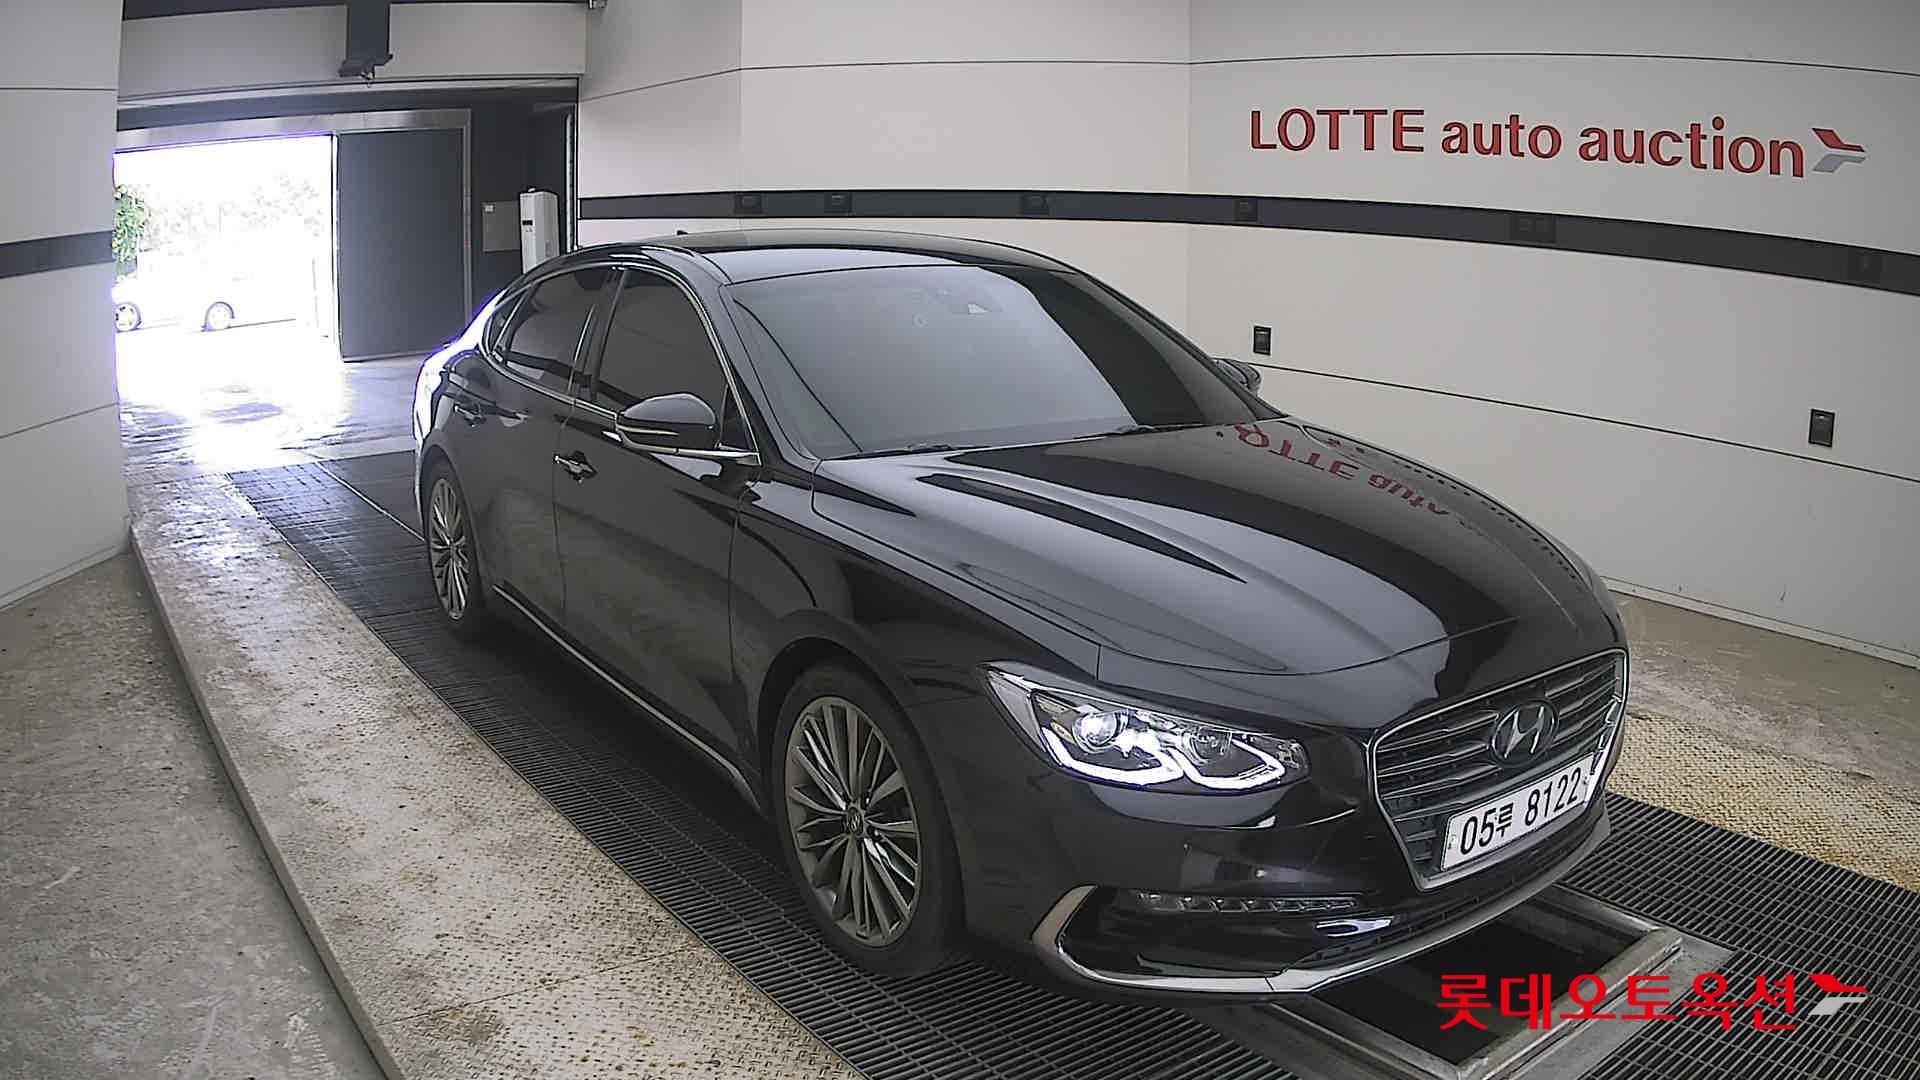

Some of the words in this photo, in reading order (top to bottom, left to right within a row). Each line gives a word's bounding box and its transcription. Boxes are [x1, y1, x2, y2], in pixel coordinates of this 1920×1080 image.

[1249, 108, 1425, 153] LOTTE
[1440, 113, 1564, 161] auto
[1577, 116, 1806, 178] auction
[1459, 801, 1515, 855] 05루
[1524, 767, 1582, 827] 8122
